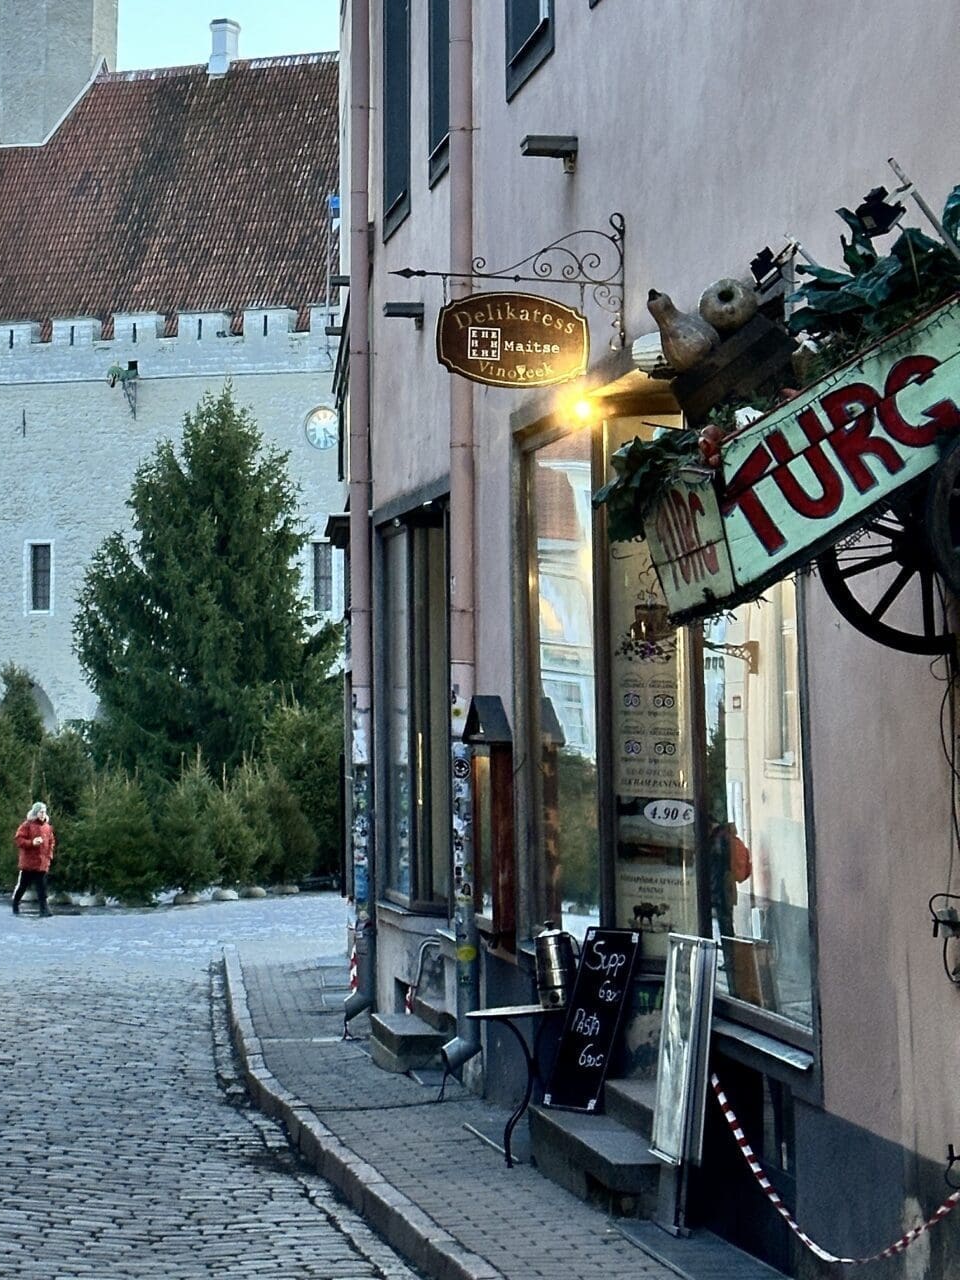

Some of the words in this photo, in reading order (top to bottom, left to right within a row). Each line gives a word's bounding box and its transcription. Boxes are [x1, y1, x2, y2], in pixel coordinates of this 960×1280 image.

[453, 301, 576, 335] Delikatess
[503, 339, 560, 354] Maitse
[721, 354, 960, 557] TURG
[650, 806, 679, 821] 4.90
[683, 808, 692, 821] €
